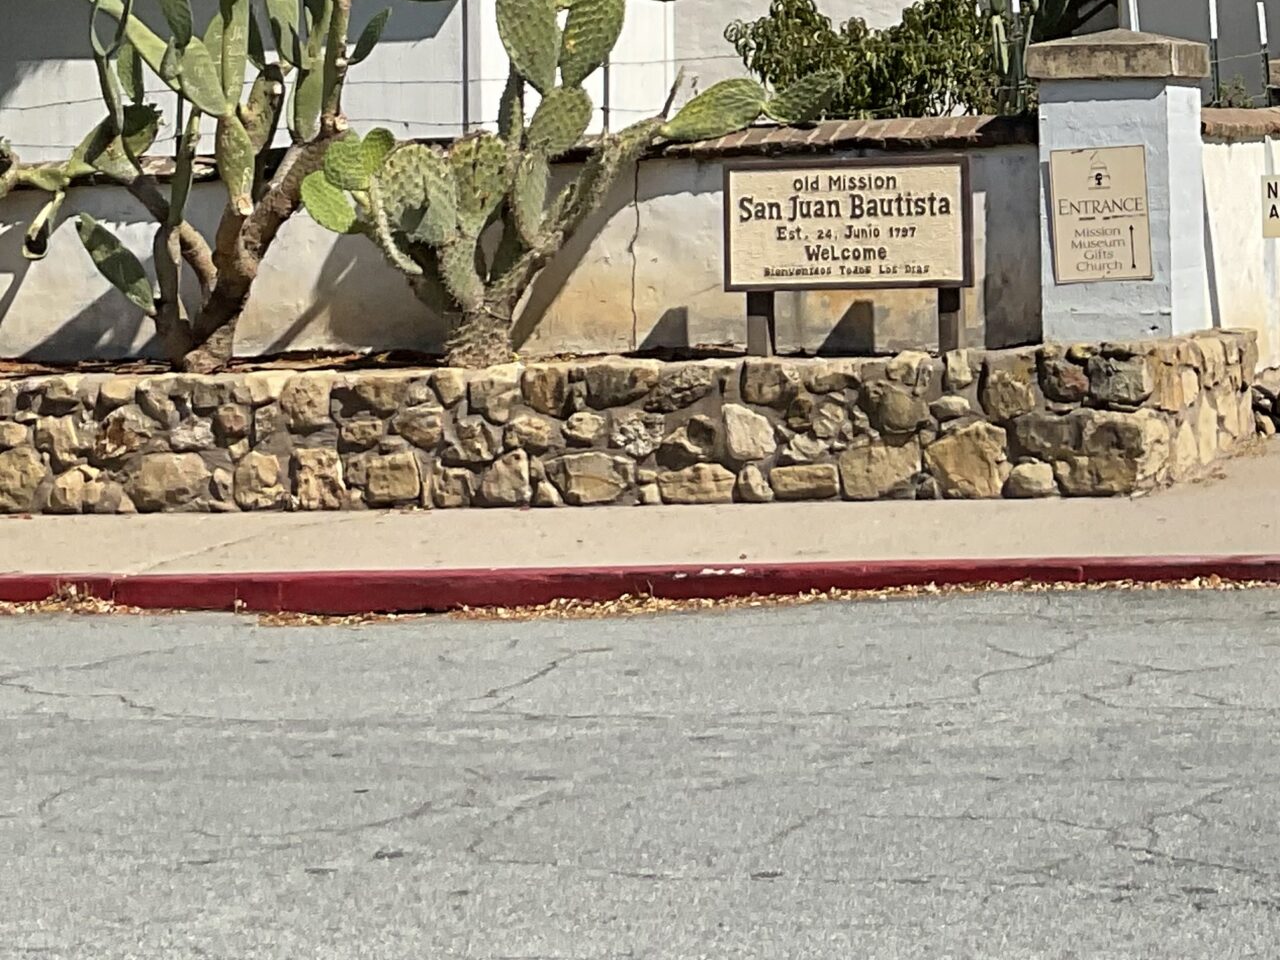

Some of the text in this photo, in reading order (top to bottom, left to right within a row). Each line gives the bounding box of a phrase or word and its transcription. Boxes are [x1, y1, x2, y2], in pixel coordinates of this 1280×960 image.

[828, 174, 897, 191] Mission
[738, 192, 951, 223] San Juan Bautista
[1058, 197, 1145, 216] ENTRANCE
[889, 226, 917, 238] 1797
[1074, 226, 1121, 238] Mission
[1071, 238, 1126, 250] Museum
[1083, 249, 1114, 260] Gifts
[1076, 260, 1123, 272] Church
